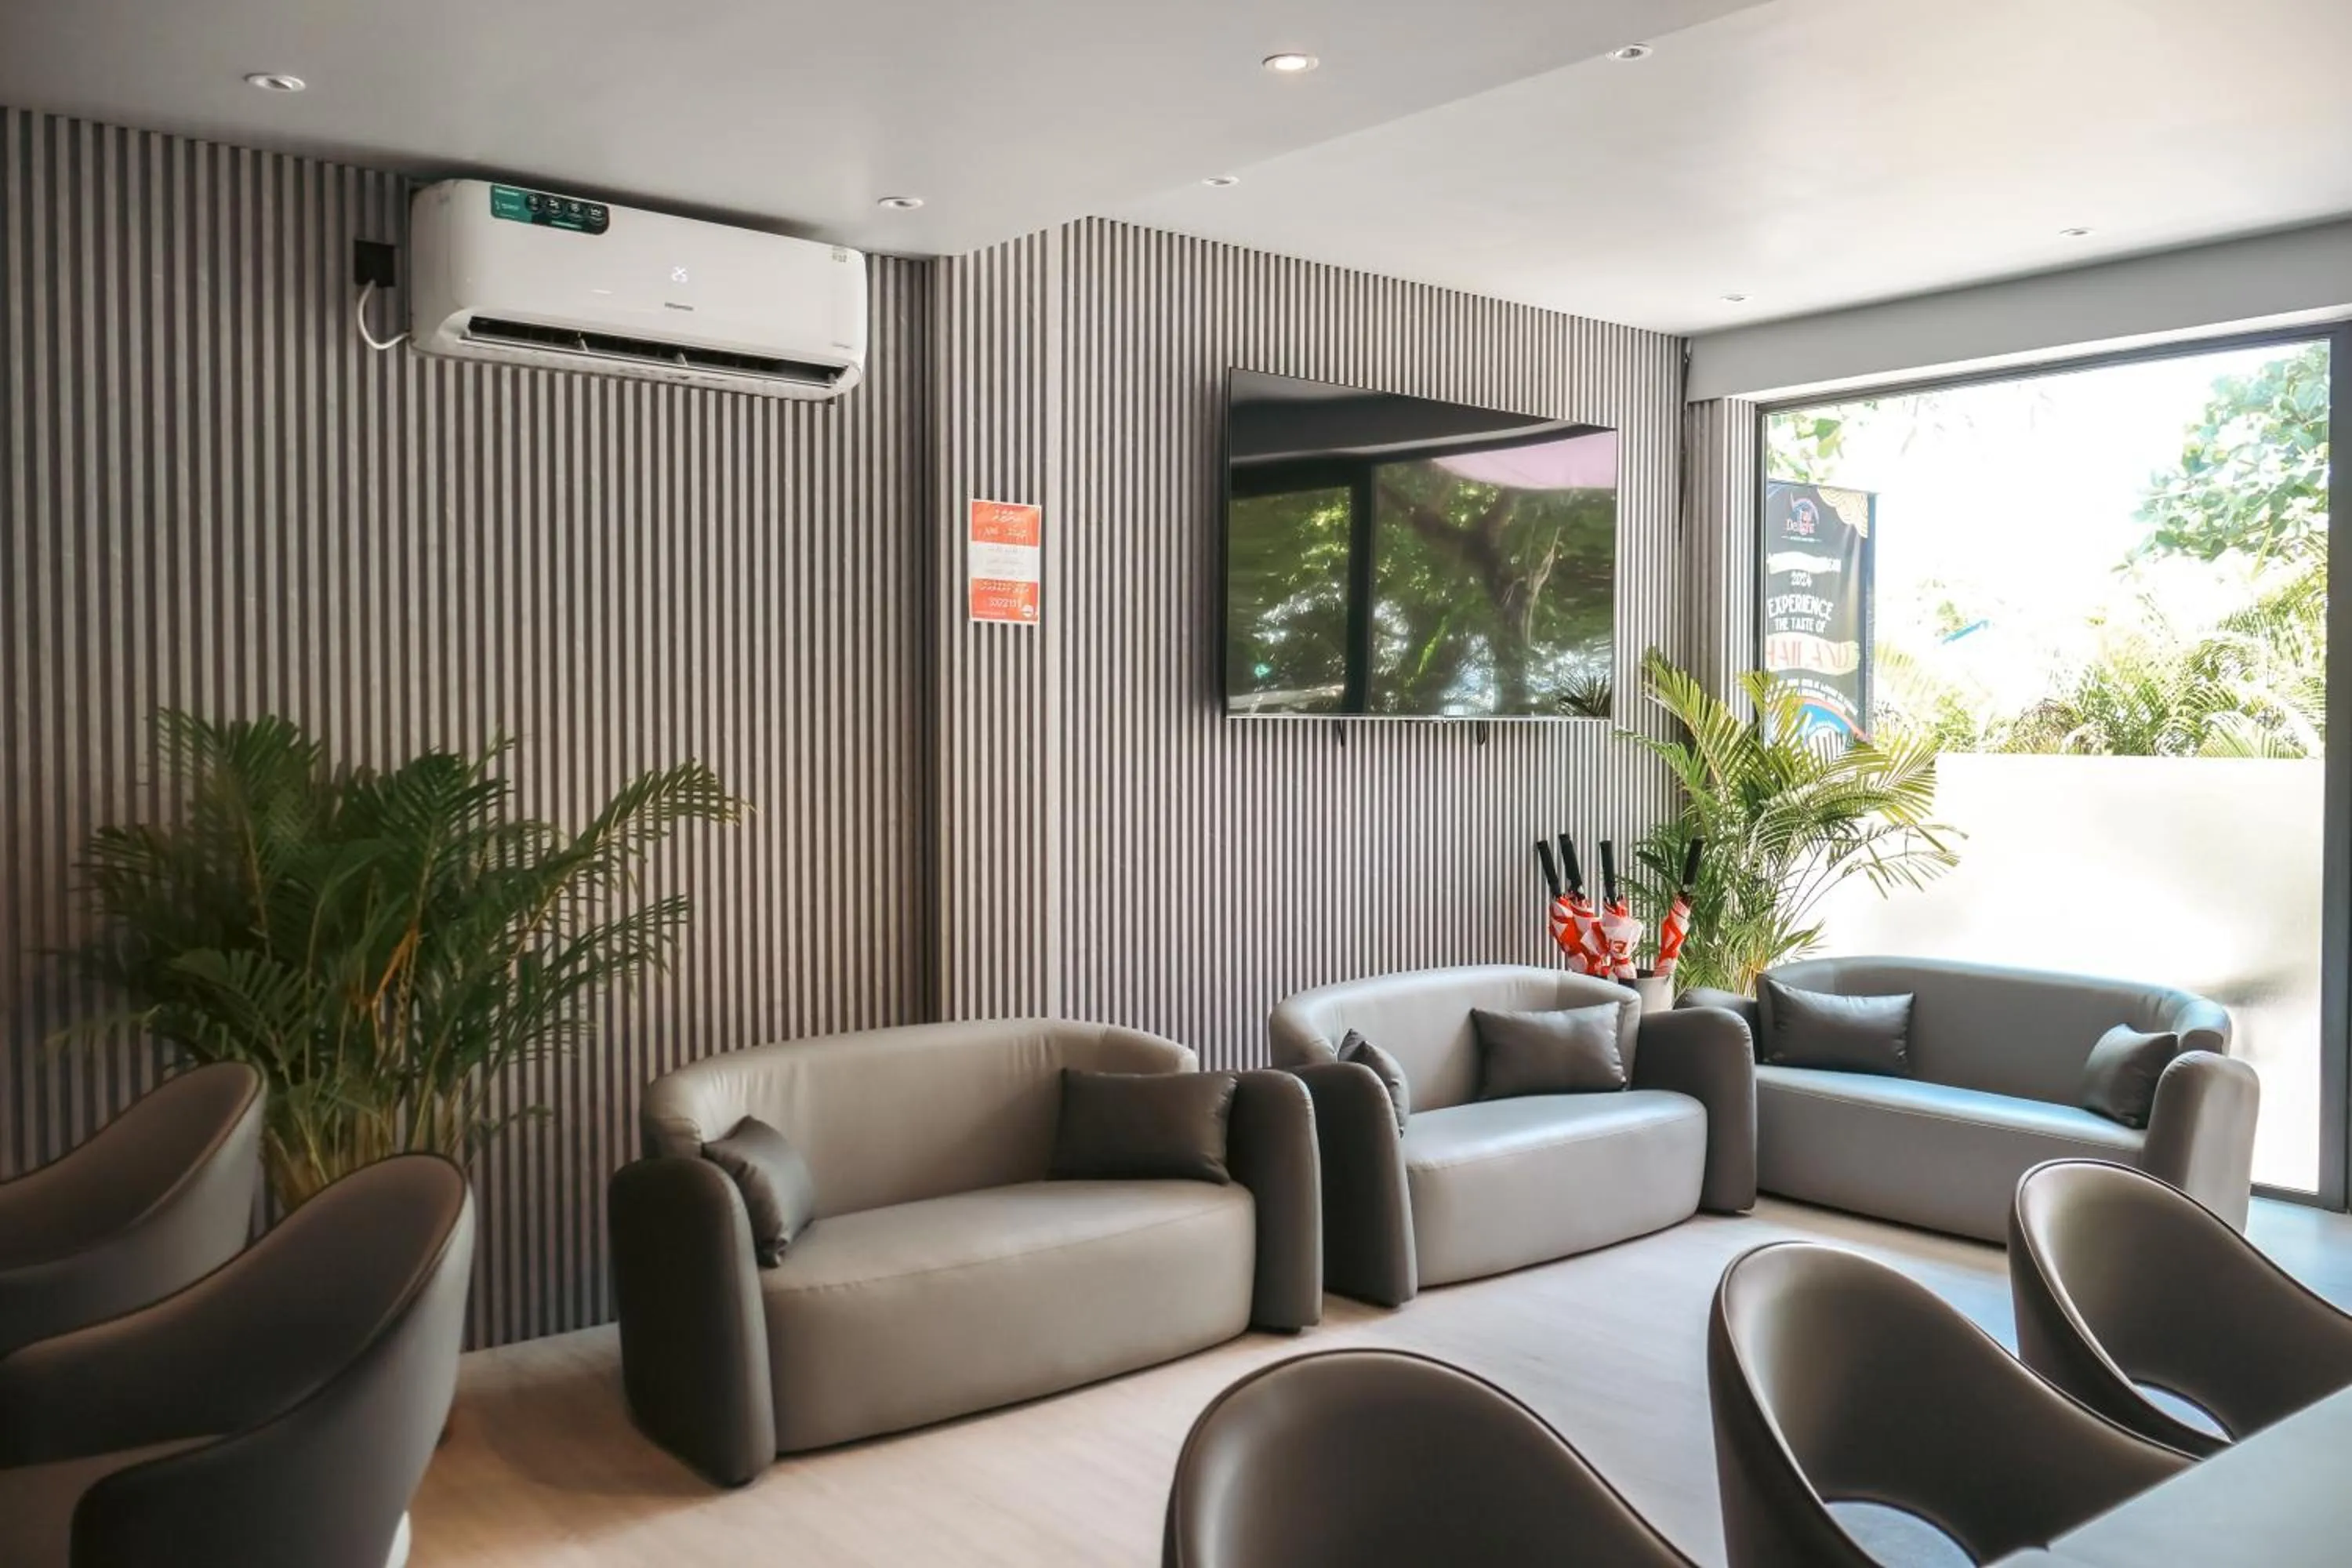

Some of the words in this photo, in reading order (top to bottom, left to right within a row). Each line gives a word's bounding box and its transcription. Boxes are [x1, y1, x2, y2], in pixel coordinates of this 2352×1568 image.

[1767, 593, 1835, 622] EXPERIENCE
[1774, 617, 1789, 631] THE
[1791, 618, 1815, 632] TASTE
[1815, 620, 1828, 633] OF
[1766, 637, 1851, 670] HAILAND
